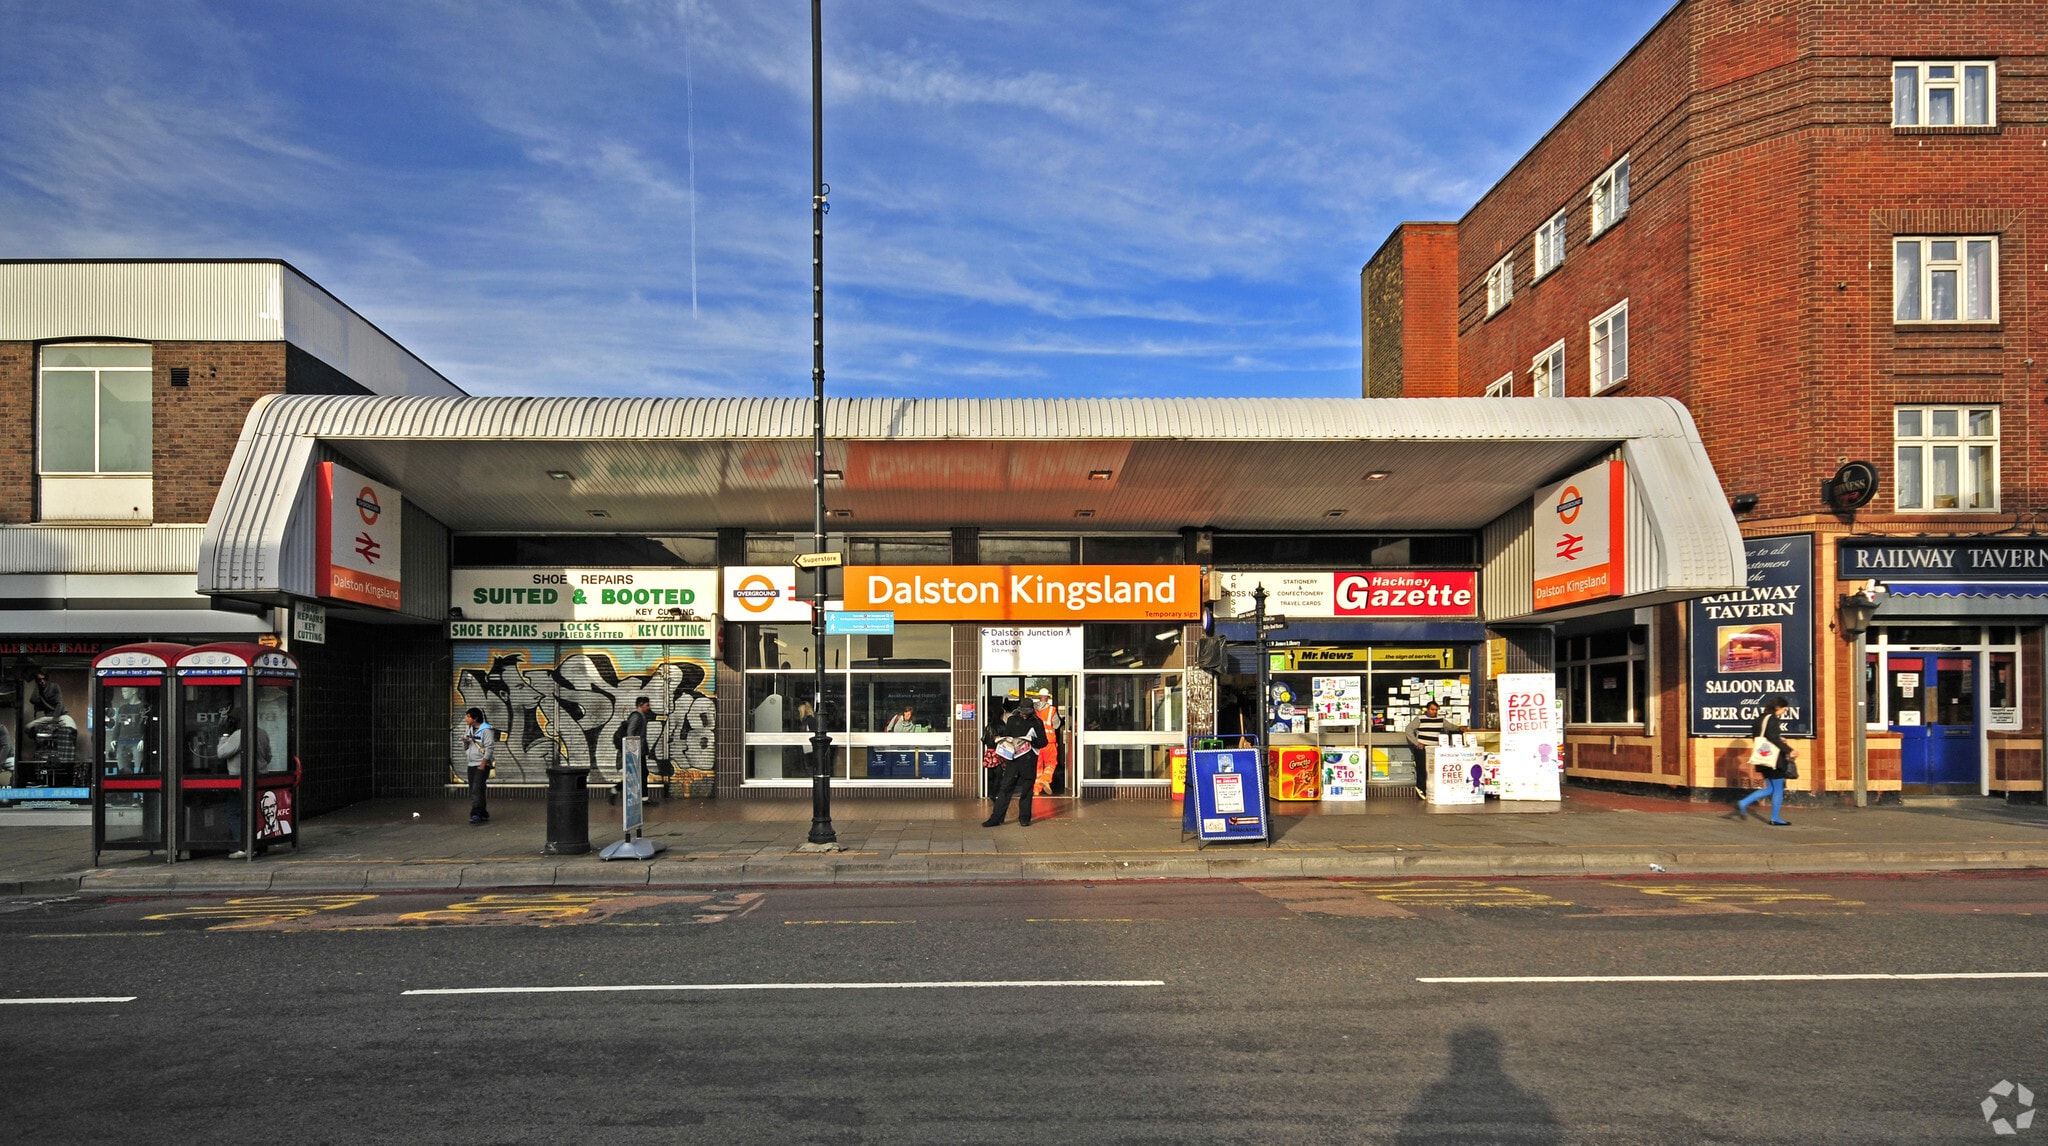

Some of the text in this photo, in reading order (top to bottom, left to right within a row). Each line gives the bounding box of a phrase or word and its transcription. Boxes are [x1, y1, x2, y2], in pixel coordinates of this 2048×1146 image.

[1770, 542, 1792, 556] all
[803, 555, 837, 564] Superstore
[1746, 560, 1791, 569] stomers
[1856, 549, 2048, 569] RAILWAY TAVERN
[533, 573, 634, 585] SHOE REPAIRS
[1372, 577, 1431, 588] Hackney
[334, 574, 399, 600] Dalston Kingsland
[1536, 572, 1607, 599] Dalston Kingsland
[473, 587, 695, 605] SUITED & BOOTED
[868, 574, 1175, 611] Dalston Kingsland
[1336, 575, 1471, 610] Gazette
[657, 608, 694, 616] CUING
[1705, 602, 1796, 620] TAVERN
[297, 611, 324, 624] REPAIRS
[304, 622, 316, 631] KEY
[452, 624, 538, 637] SHOE REPAIRS
[560, 623, 600, 631] LOCKS
[638, 624, 705, 637] KEY CUTTING
[298, 630, 322, 641] CUTTING
[542, 631, 585, 639] SUPPLIED
[991, 629, 1064, 637] Dalston Junction
[27, 643, 59, 653] SALE
[66, 643, 99, 653] SALE
[1301, 651, 1354, 660] Mr. News
[1705, 679, 1796, 694] SALOON BAR
[1508, 693, 1545, 708] £20
[1740, 693, 1766, 705] and
[197, 713, 219, 722] BT
[1508, 708, 1548, 722] FREE
[1702, 706, 1801, 720] BEER GAEN
[1509, 721, 1549, 732] CREDIT
[1442, 764, 1462, 772] £20
[277, 808, 290, 816] KFC
